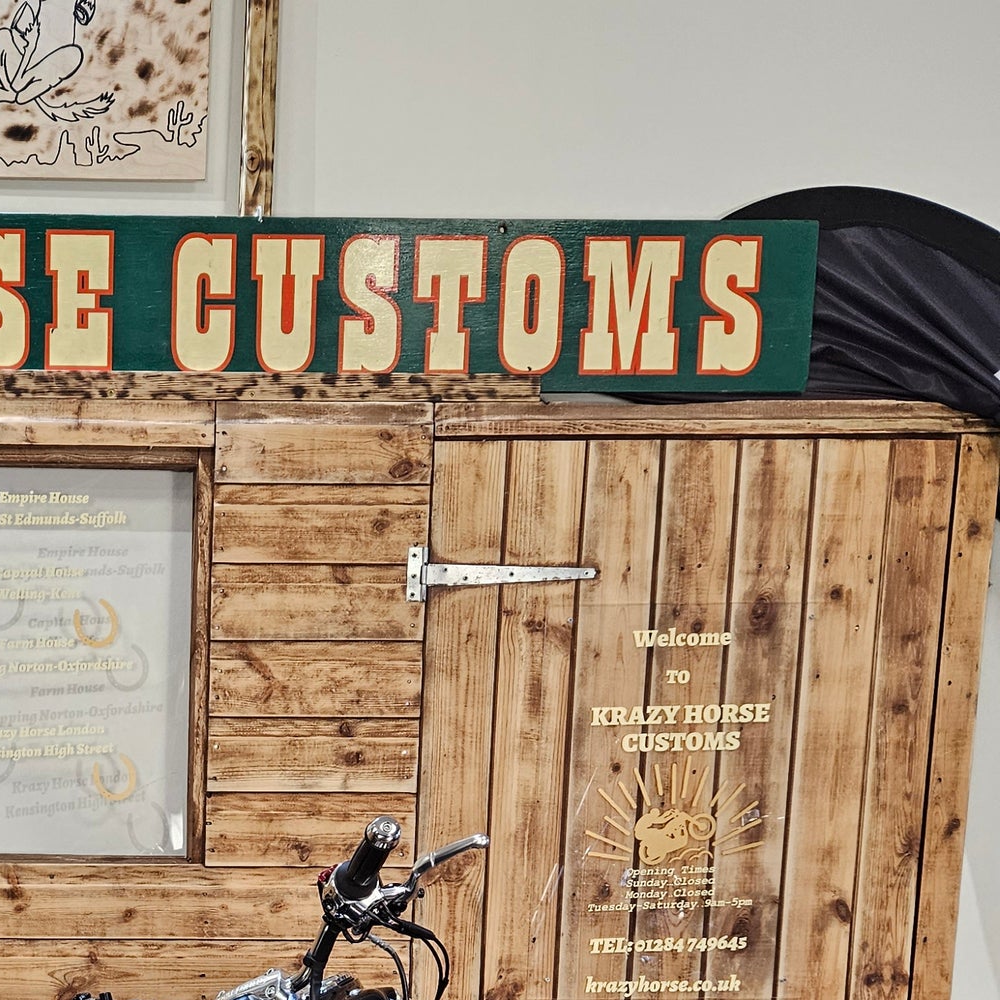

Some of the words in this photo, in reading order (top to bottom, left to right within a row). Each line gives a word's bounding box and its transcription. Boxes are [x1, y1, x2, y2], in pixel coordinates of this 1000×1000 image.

[172, 232, 762, 376] CUSTOMS
[49, 491, 89, 504] House
[14, 511, 127, 527] Edmunds-Suffolk
[45, 566, 87, 578] House
[0, 637, 38, 648] Farm
[39, 637, 74, 648] House
[634, 628, 732, 648] Welcome
[8, 659, 134, 674] Norton-Oxfordshire
[591, 705, 681, 727] KRAZY
[684, 703, 771, 724] HORSE
[20, 725, 55, 737] Horse
[58, 725, 105, 736] London
[622, 731, 741, 752] CUSTOMS
[44, 744, 74, 757] High
[77, 743, 114, 755] Street
[626, 866, 675, 877] Opening
[682, 865, 716, 874] Times
[687, 936, 747, 951] 749645
[585, 975, 741, 997] krazyhorse.co.uk
